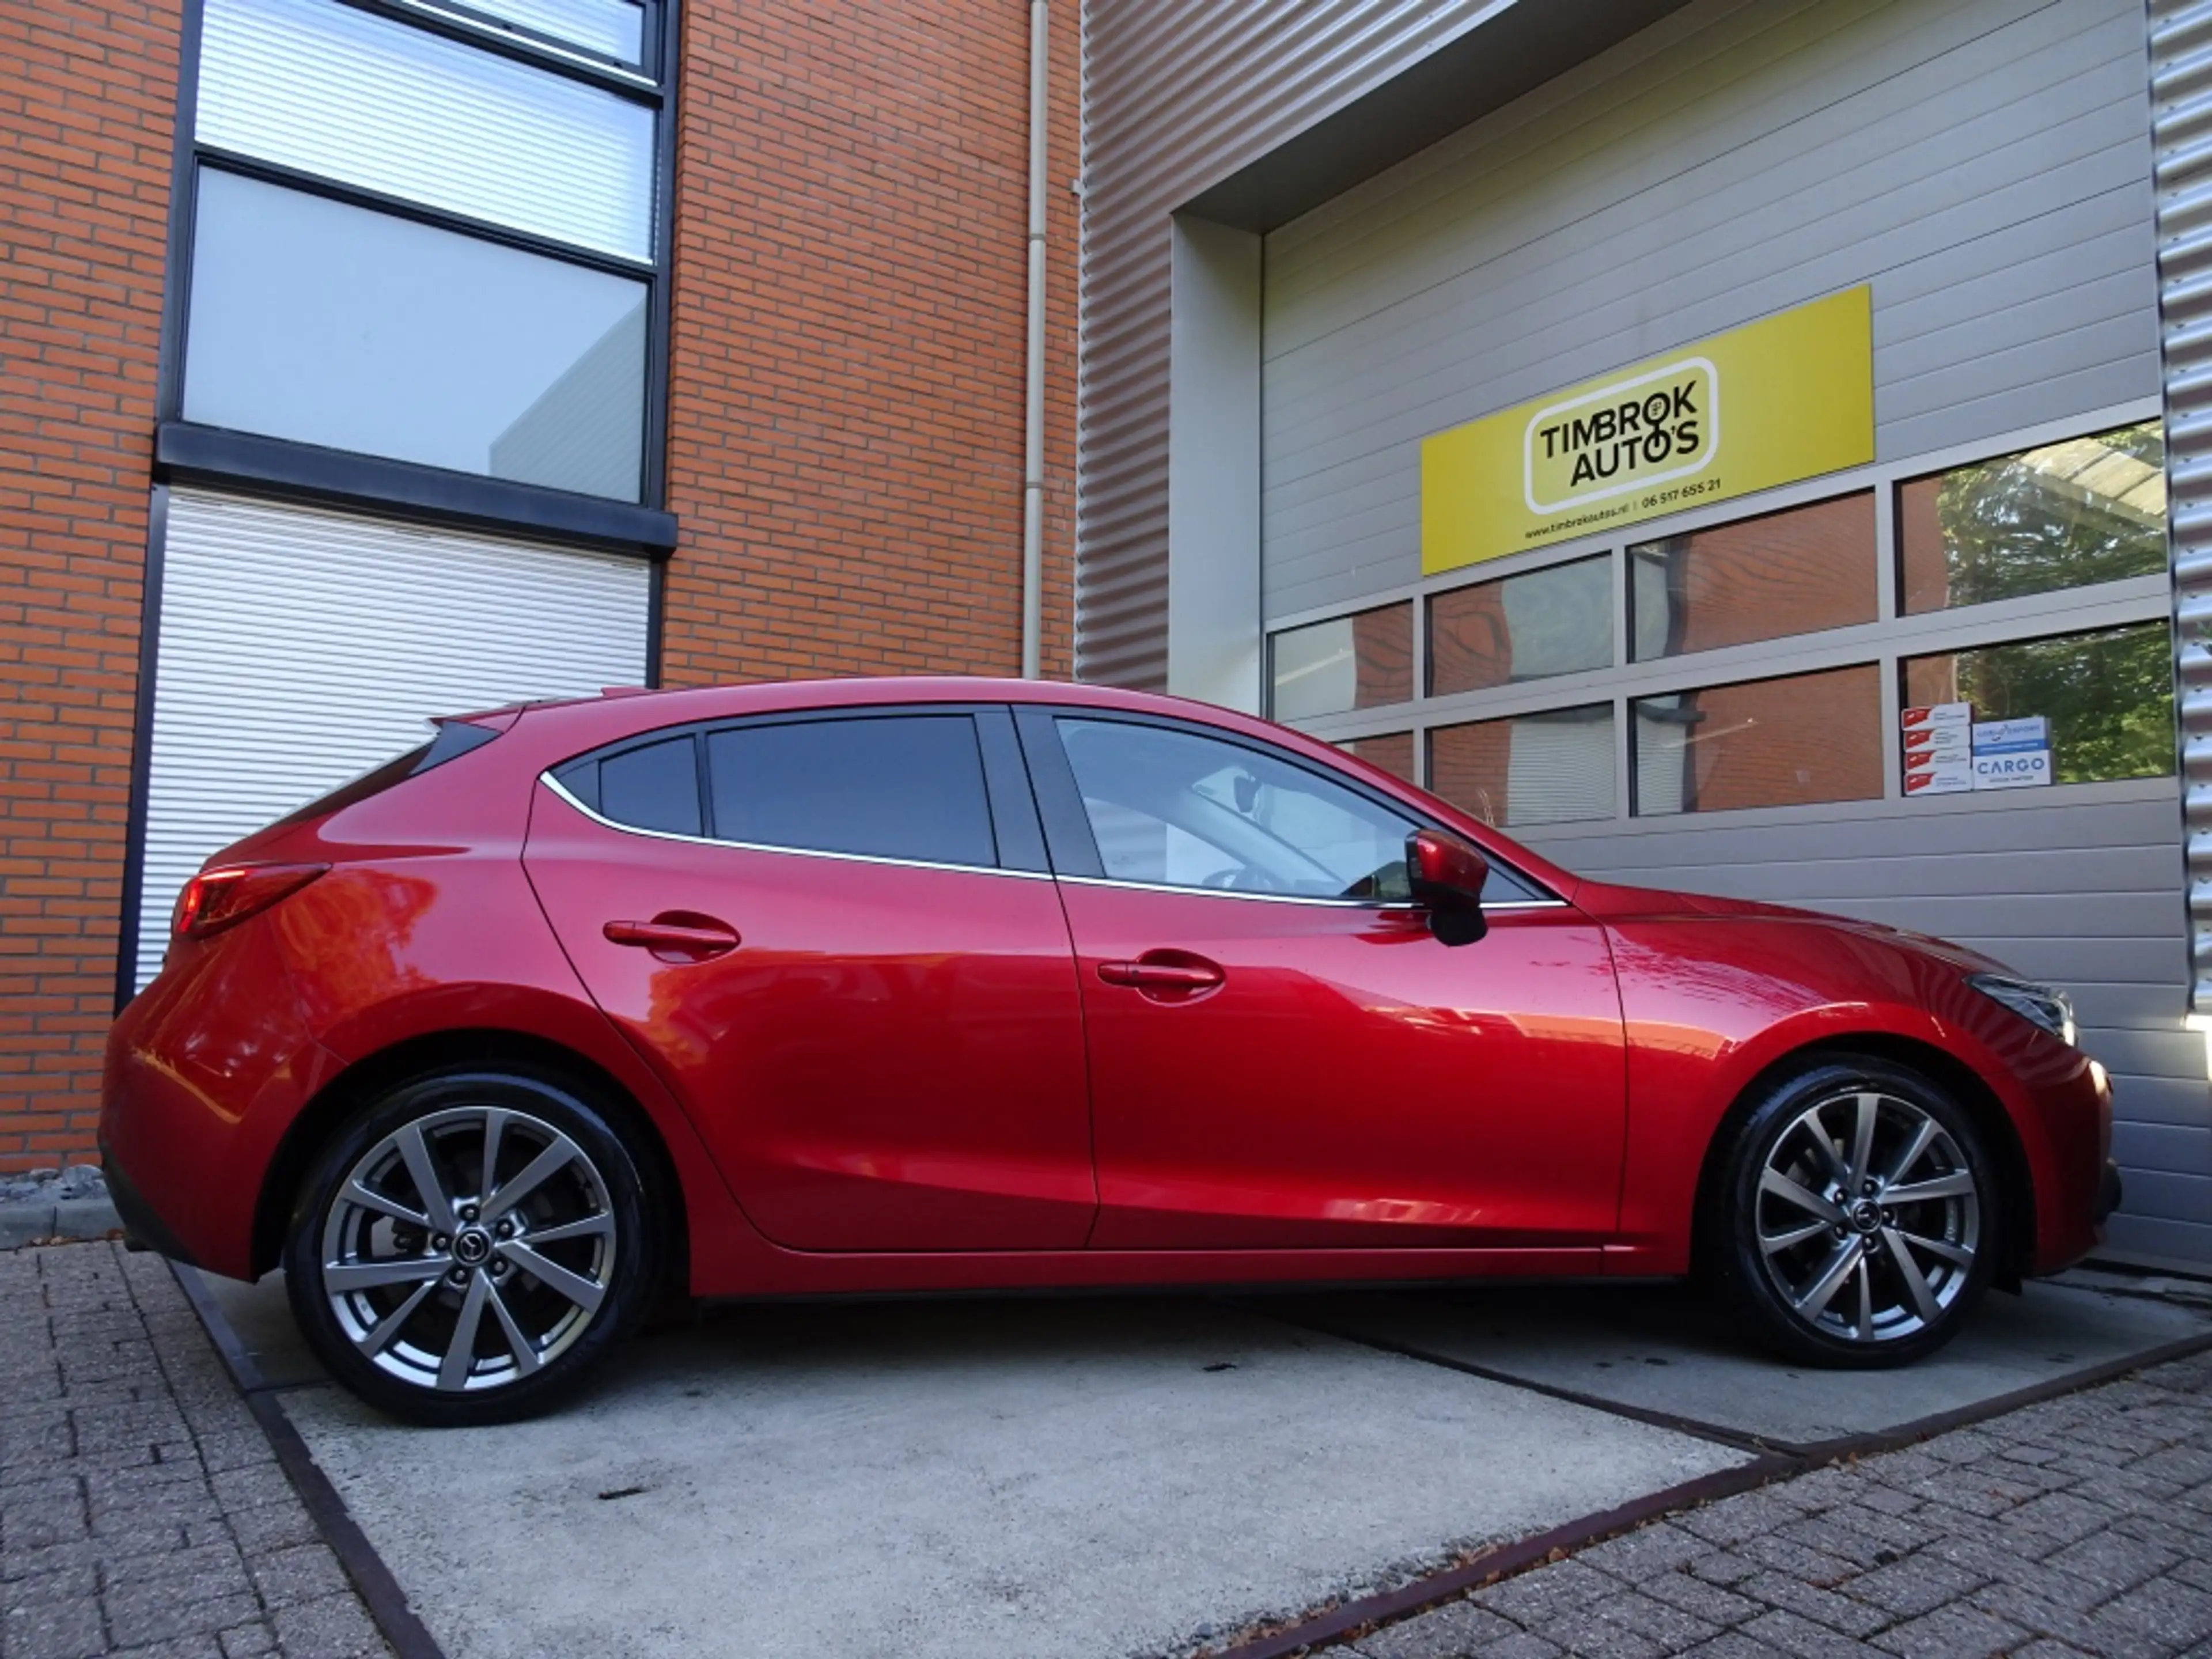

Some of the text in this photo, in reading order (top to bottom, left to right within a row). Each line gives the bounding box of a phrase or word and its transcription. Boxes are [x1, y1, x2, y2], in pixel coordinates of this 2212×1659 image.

[1540, 380, 1697, 459] TIMBROK
[1570, 421, 1699, 487] AUTO'S
[1642, 494, 1657, 508] 06
[1660, 489, 1679, 503] 517
[1681, 482, 1705, 498] 655
[1707, 478, 1721, 491] 21
[1977, 757, 2045, 774] CARGO
